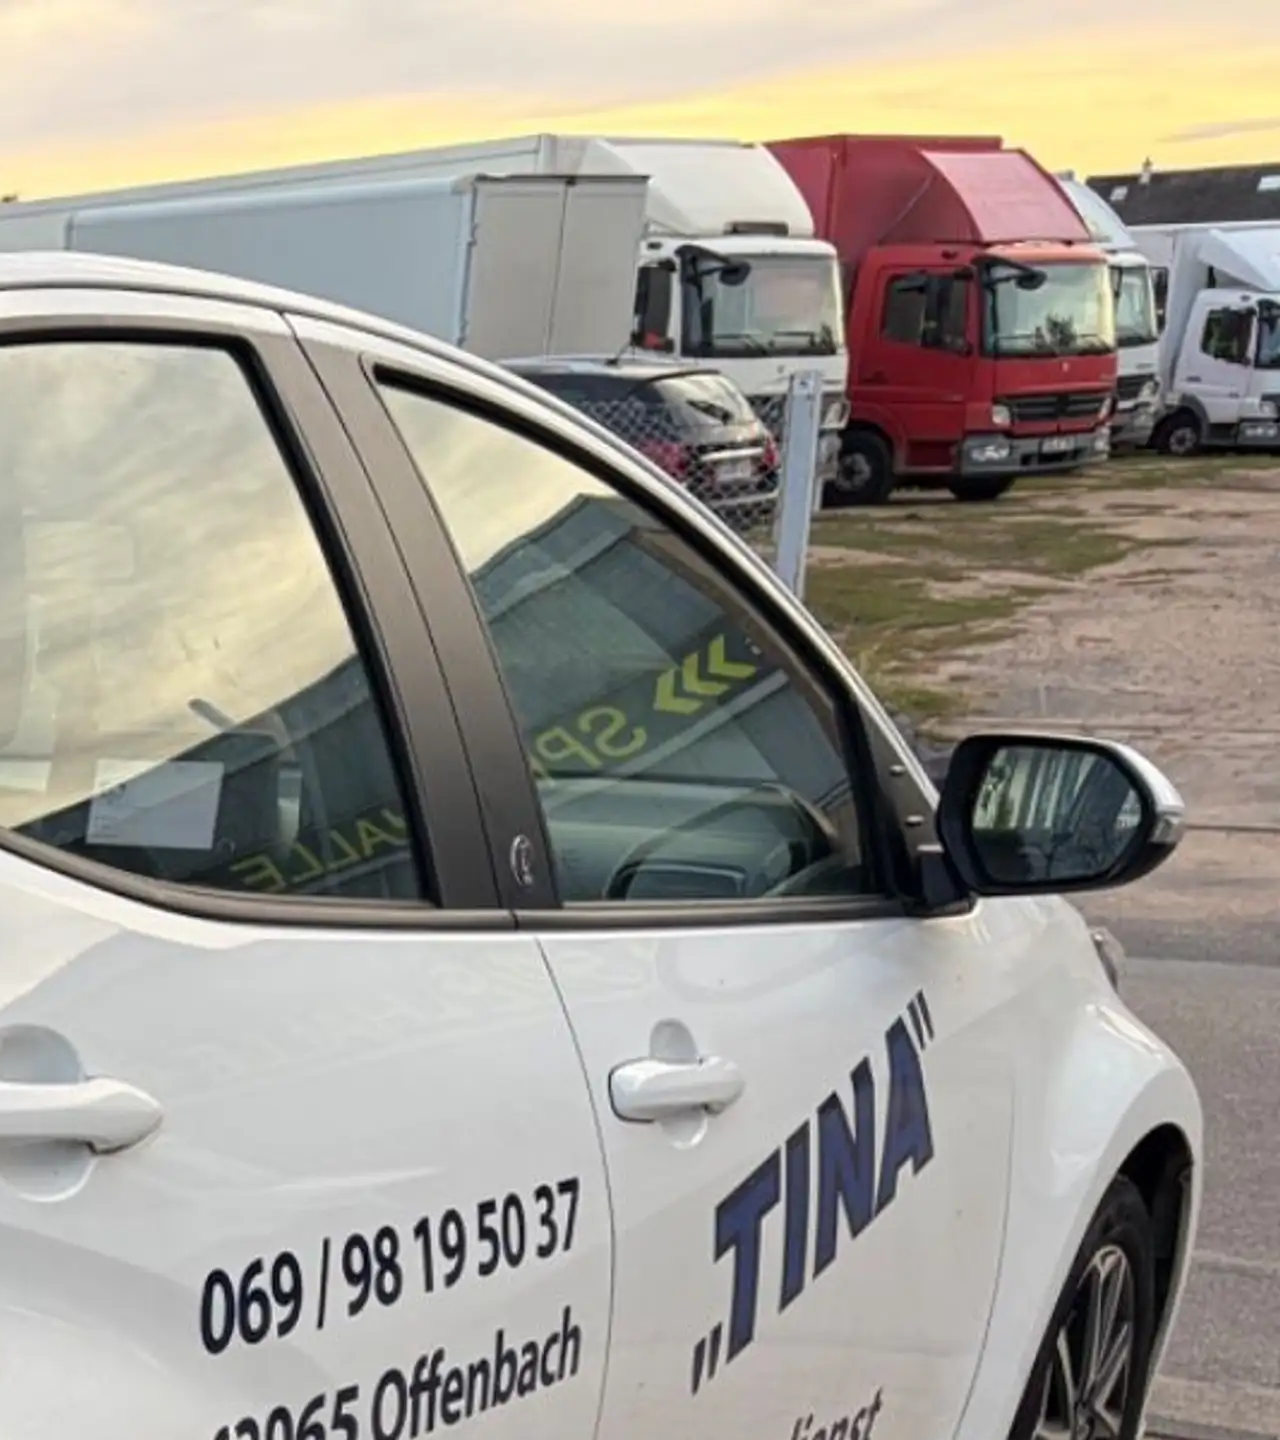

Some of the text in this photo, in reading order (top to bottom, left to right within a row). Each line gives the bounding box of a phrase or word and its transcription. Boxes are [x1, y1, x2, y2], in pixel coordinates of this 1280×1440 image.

[199, 1250, 304, 1355] 069
[342, 1224, 403, 1318] 98
[412, 1207, 467, 1294] 19
[476, 1191, 526, 1278] 50
[533, 1176, 580, 1260] 37
